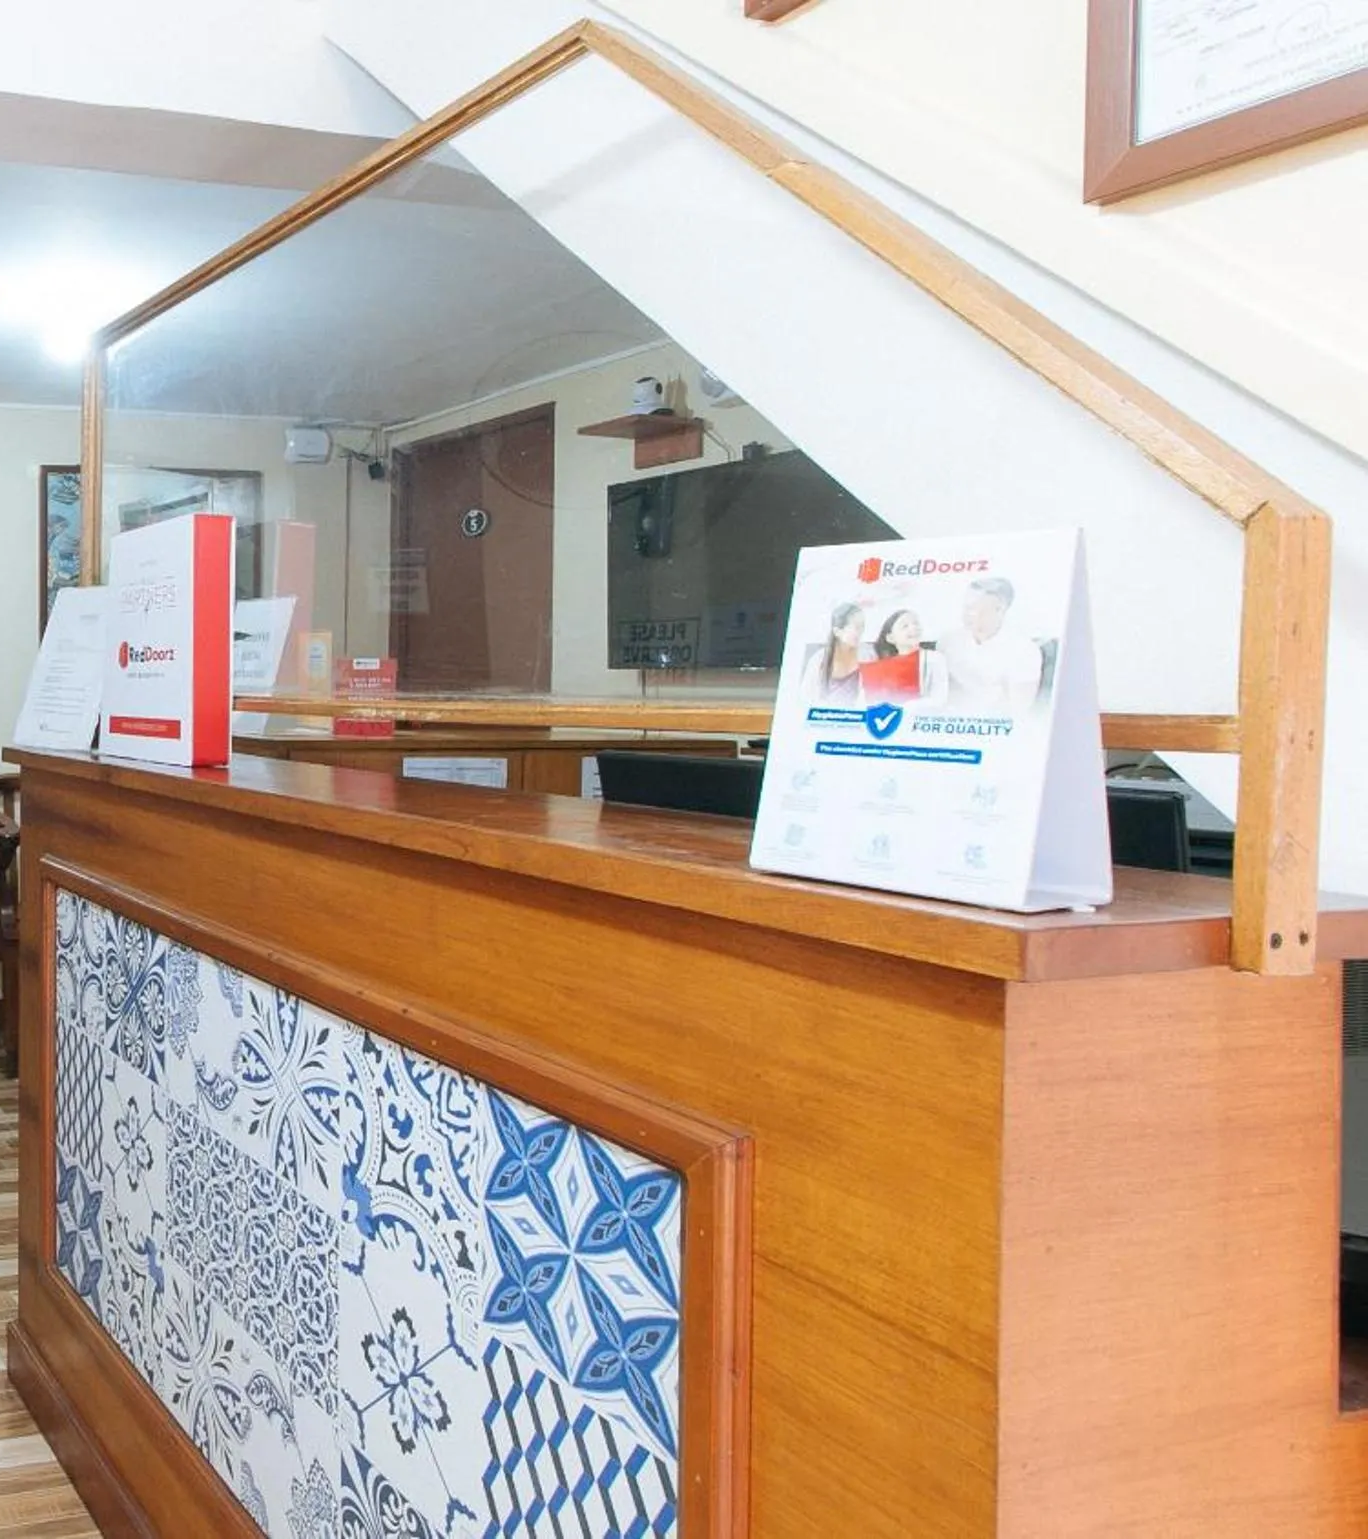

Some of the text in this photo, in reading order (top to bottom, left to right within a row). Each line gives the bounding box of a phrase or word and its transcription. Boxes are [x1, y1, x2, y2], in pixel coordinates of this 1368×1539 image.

[469, 518, 479, 531] 5
[882, 559, 989, 577] RedDoorz
[129, 646, 175, 663] RedDoorz
[913, 722, 1013, 736] FOR QUALITY
